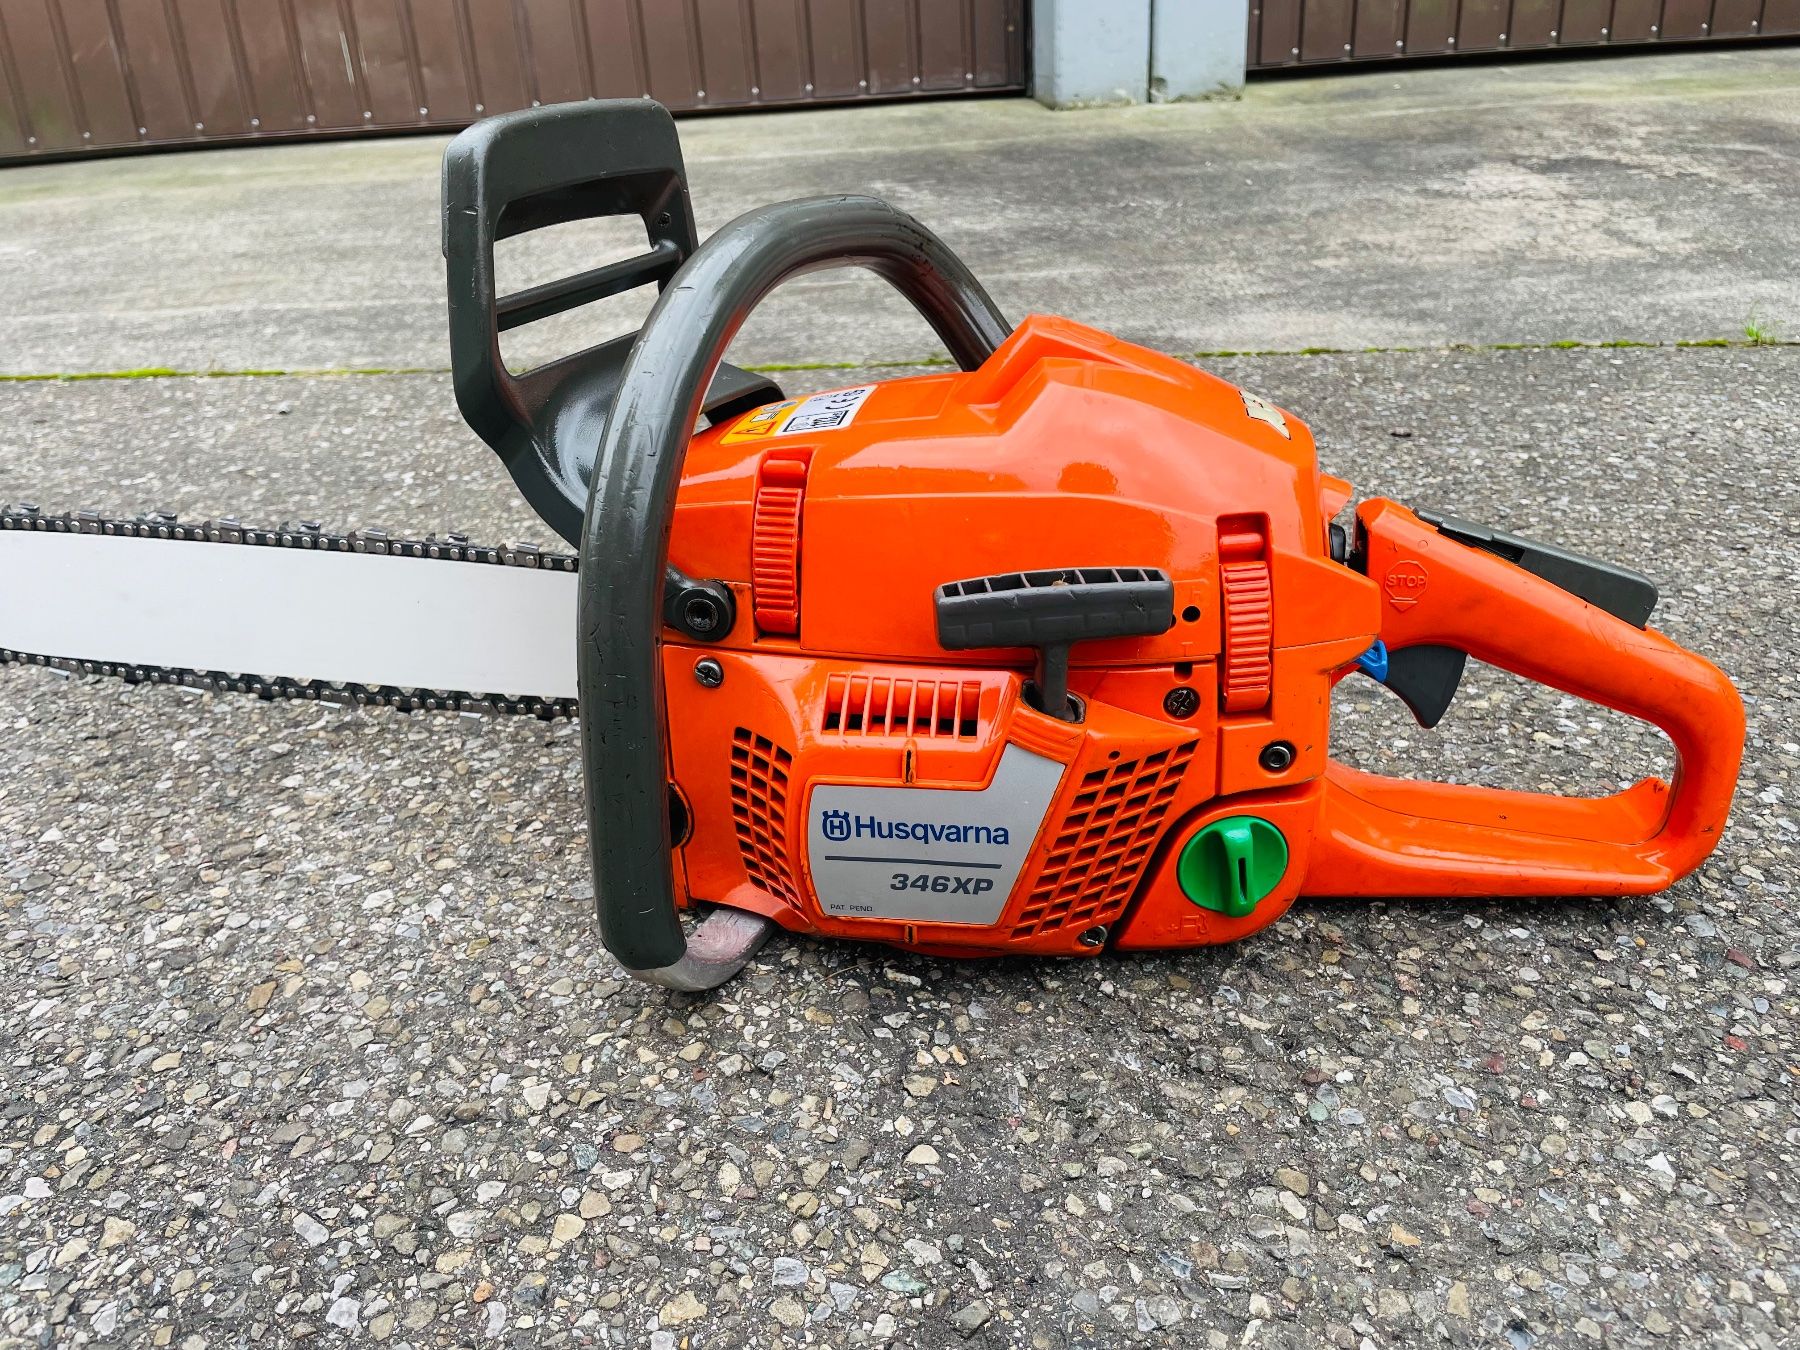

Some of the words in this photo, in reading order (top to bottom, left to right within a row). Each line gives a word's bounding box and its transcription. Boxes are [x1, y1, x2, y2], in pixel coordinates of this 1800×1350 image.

[1386, 574, 1426, 588] STOP
[854, 815, 1010, 845] Husqvarna
[890, 873, 994, 896] 346XP
[830, 903, 846, 911] PAT
